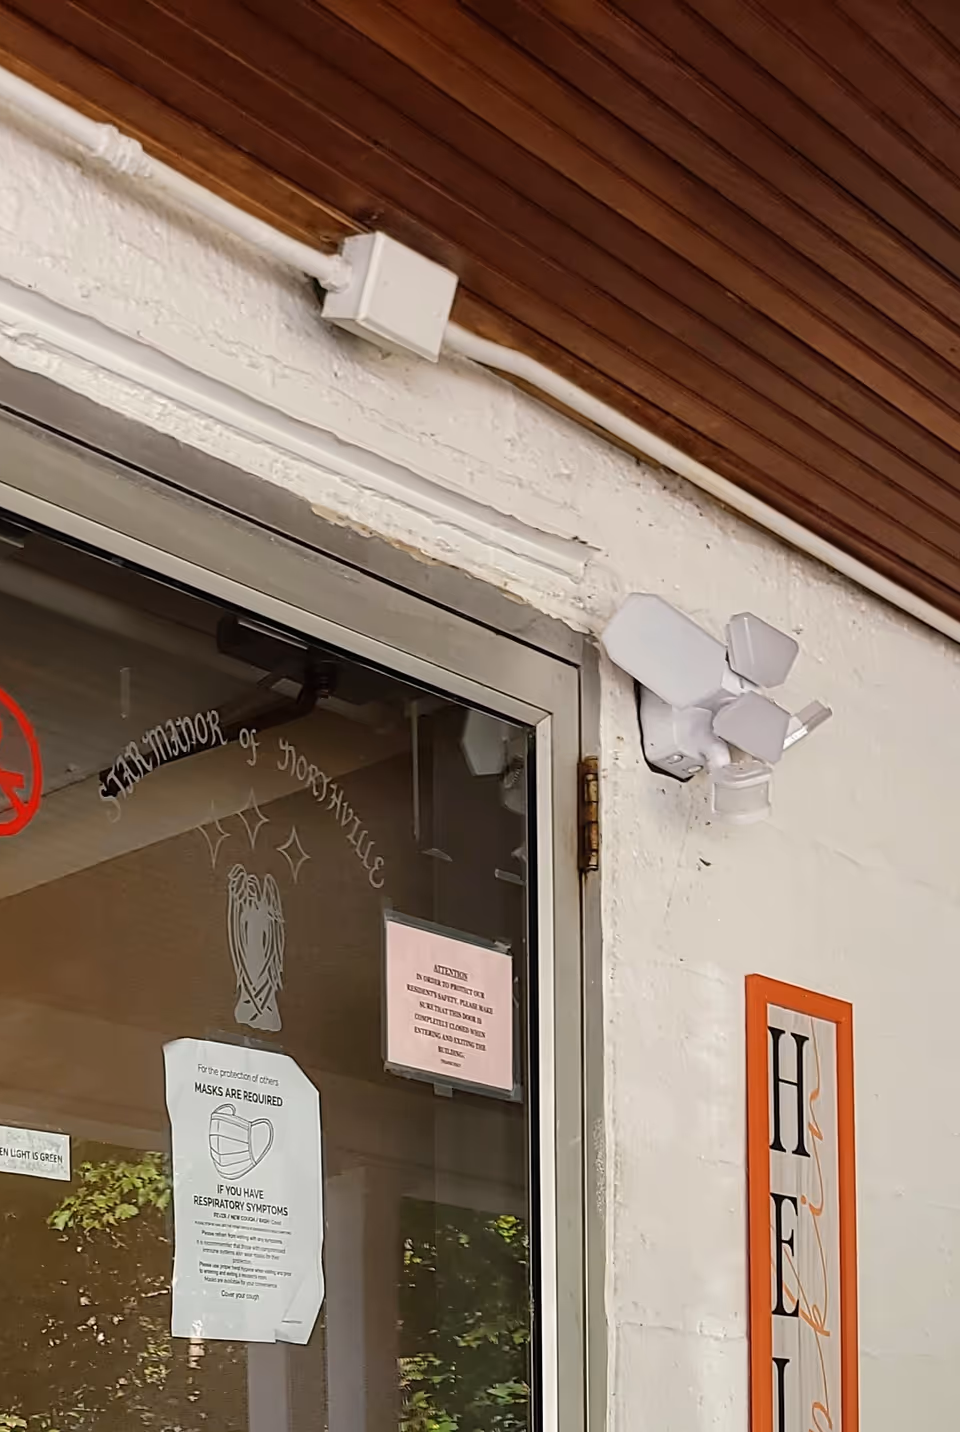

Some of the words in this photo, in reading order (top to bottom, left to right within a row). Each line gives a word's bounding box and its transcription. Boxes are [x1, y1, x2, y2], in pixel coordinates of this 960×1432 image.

[98, 740, 152, 823] STAR
[277, 738, 384, 888] NORTHVILLE
[434, 964, 468, 981] ATTENTION
[424, 976, 441, 986] ORDER
[450, 984, 473, 995] PROTECT
[474, 990, 485, 999] OUR
[420, 1001, 433, 1010] SURE
[434, 1005, 448, 1015] THAT
[449, 1010, 461, 1018] THIS
[463, 1013, 476, 1022] DOOR
[460, 999, 478, 1010] PLEASE
[479, 1004, 493, 1014] MAKE
[414, 1013, 448, 1028] COMPLETELY
[449, 1022, 469, 1033] CLOSED
[470, 1028, 486, 1038] WHEN
[414, 1026, 441, 1039] ENTERING
[442, 1034, 453, 1042] AND
[454, 1037, 475, 1048] EXITING
[476, 1043, 486, 1051] THE
[198, 1064, 207, 1073] For
[208, 1067, 218, 1075] the
[220, 1069, 251, 1080] protection
[252, 1074, 258, 1082] of
[260, 1076, 278, 1086] others
[194, 1082, 223, 1096] MASKS
[225, 1088, 242, 1100] ARE
[243, 1090, 283, 1107] REQUIRED
[10, 1150, 30, 1160] LIGHT
[40, 1153, 63, 1163] GREEN
[217, 1184, 224, 1194] IF
[226, 1185, 242, 1196] YOU
[243, 1188, 264, 1199] HAVE
[193, 1195, 244, 1210] RESPIRATORY
[246, 1203, 288, 1216] SYMPTOMS
